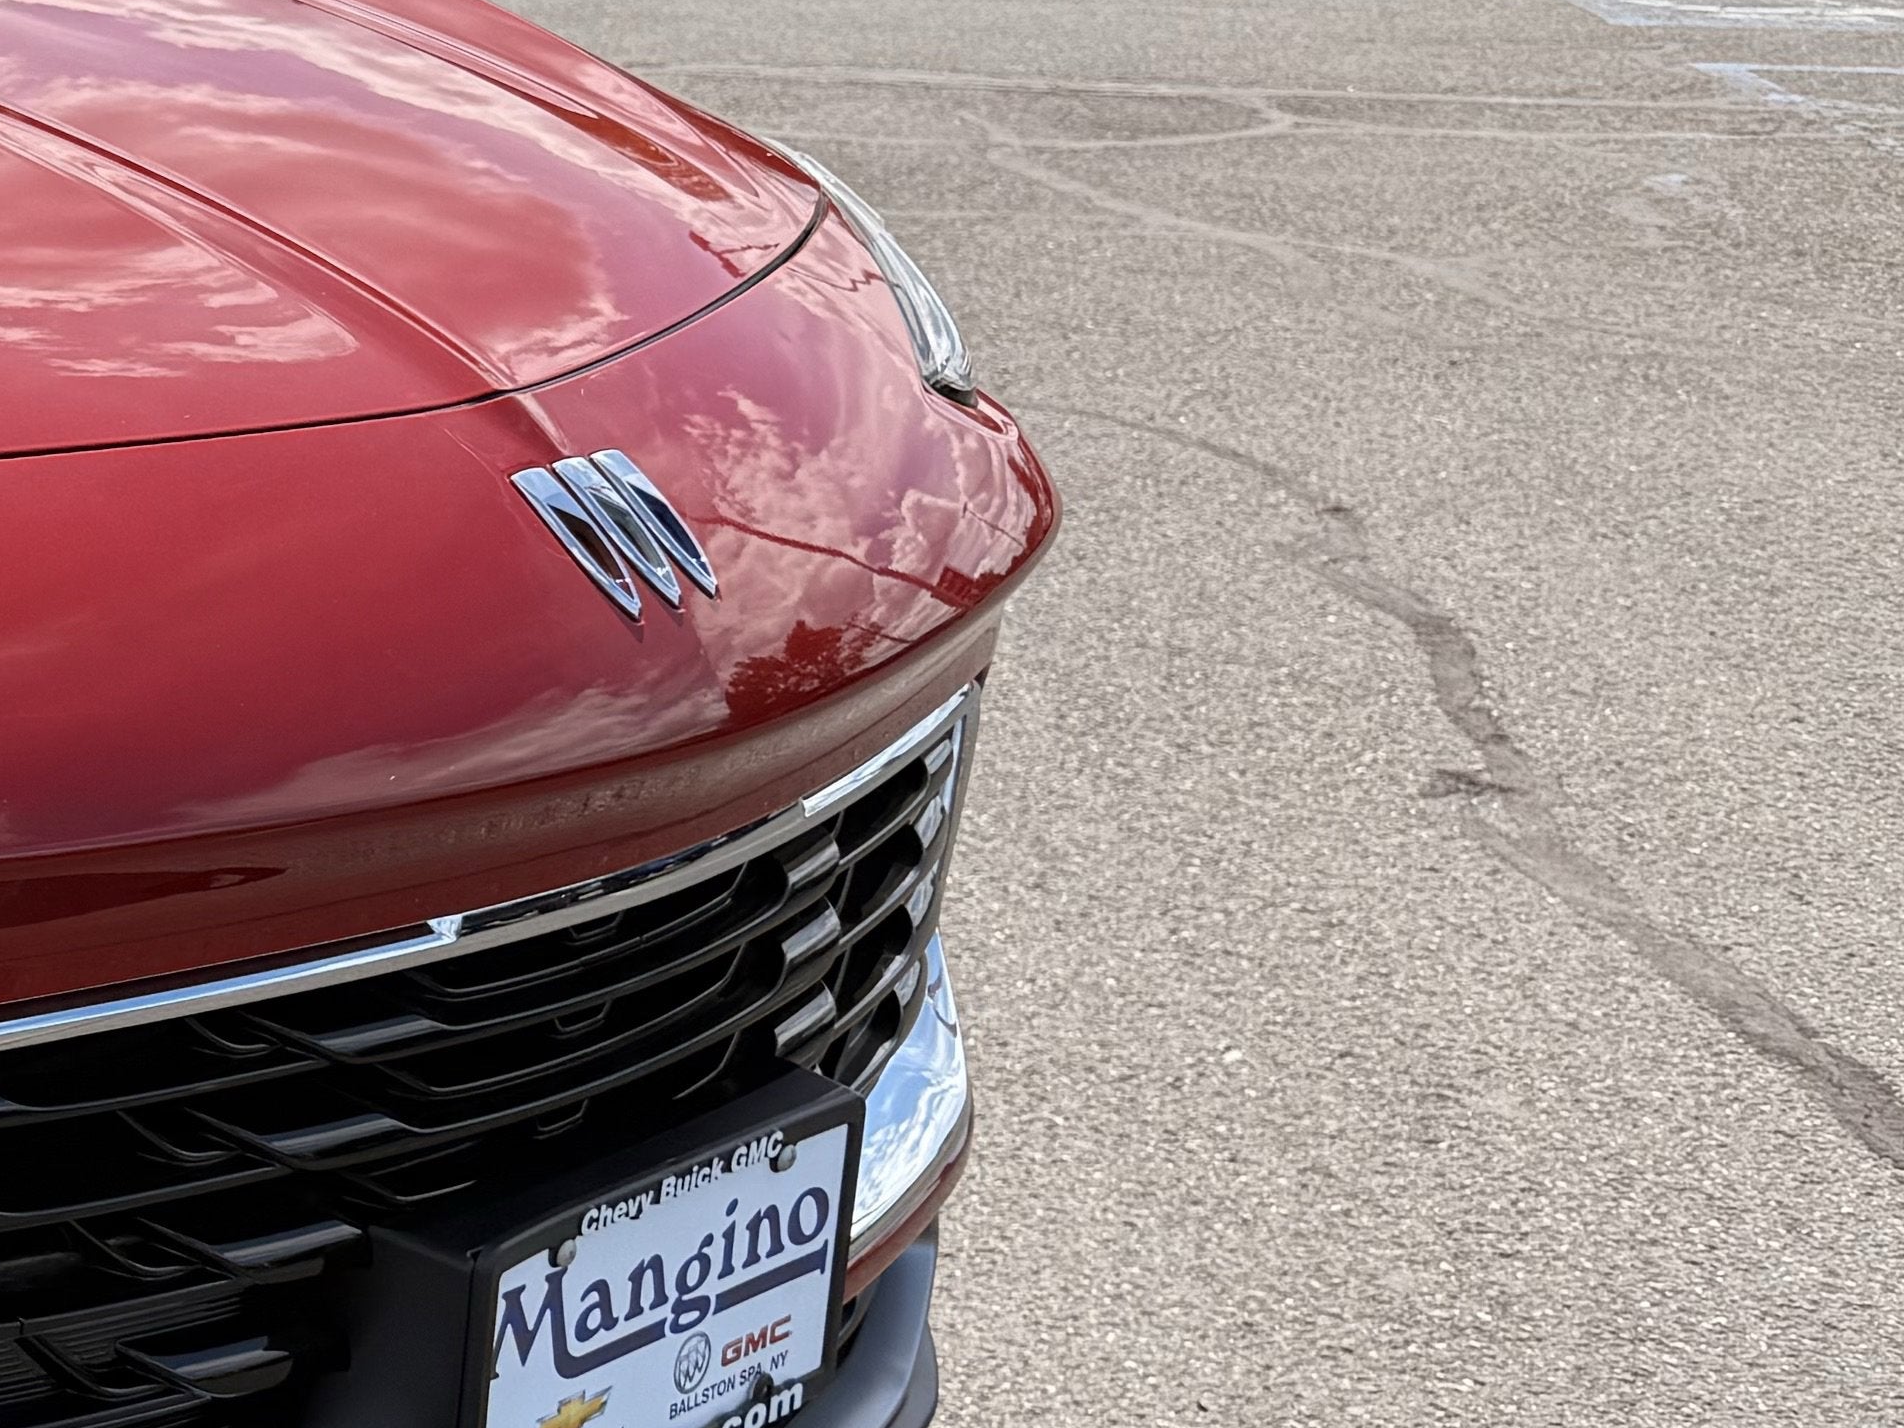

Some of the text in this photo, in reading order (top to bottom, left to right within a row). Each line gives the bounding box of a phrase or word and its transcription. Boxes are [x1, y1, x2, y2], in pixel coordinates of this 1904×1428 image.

[581, 1130, 783, 1236] Chevy Buick GMC
[490, 1186, 830, 1379] Mangino
[669, 1373, 736, 1420] BALLSTON
[769, 1349, 789, 1372] NY
[721, 1314, 792, 1367] GMC
